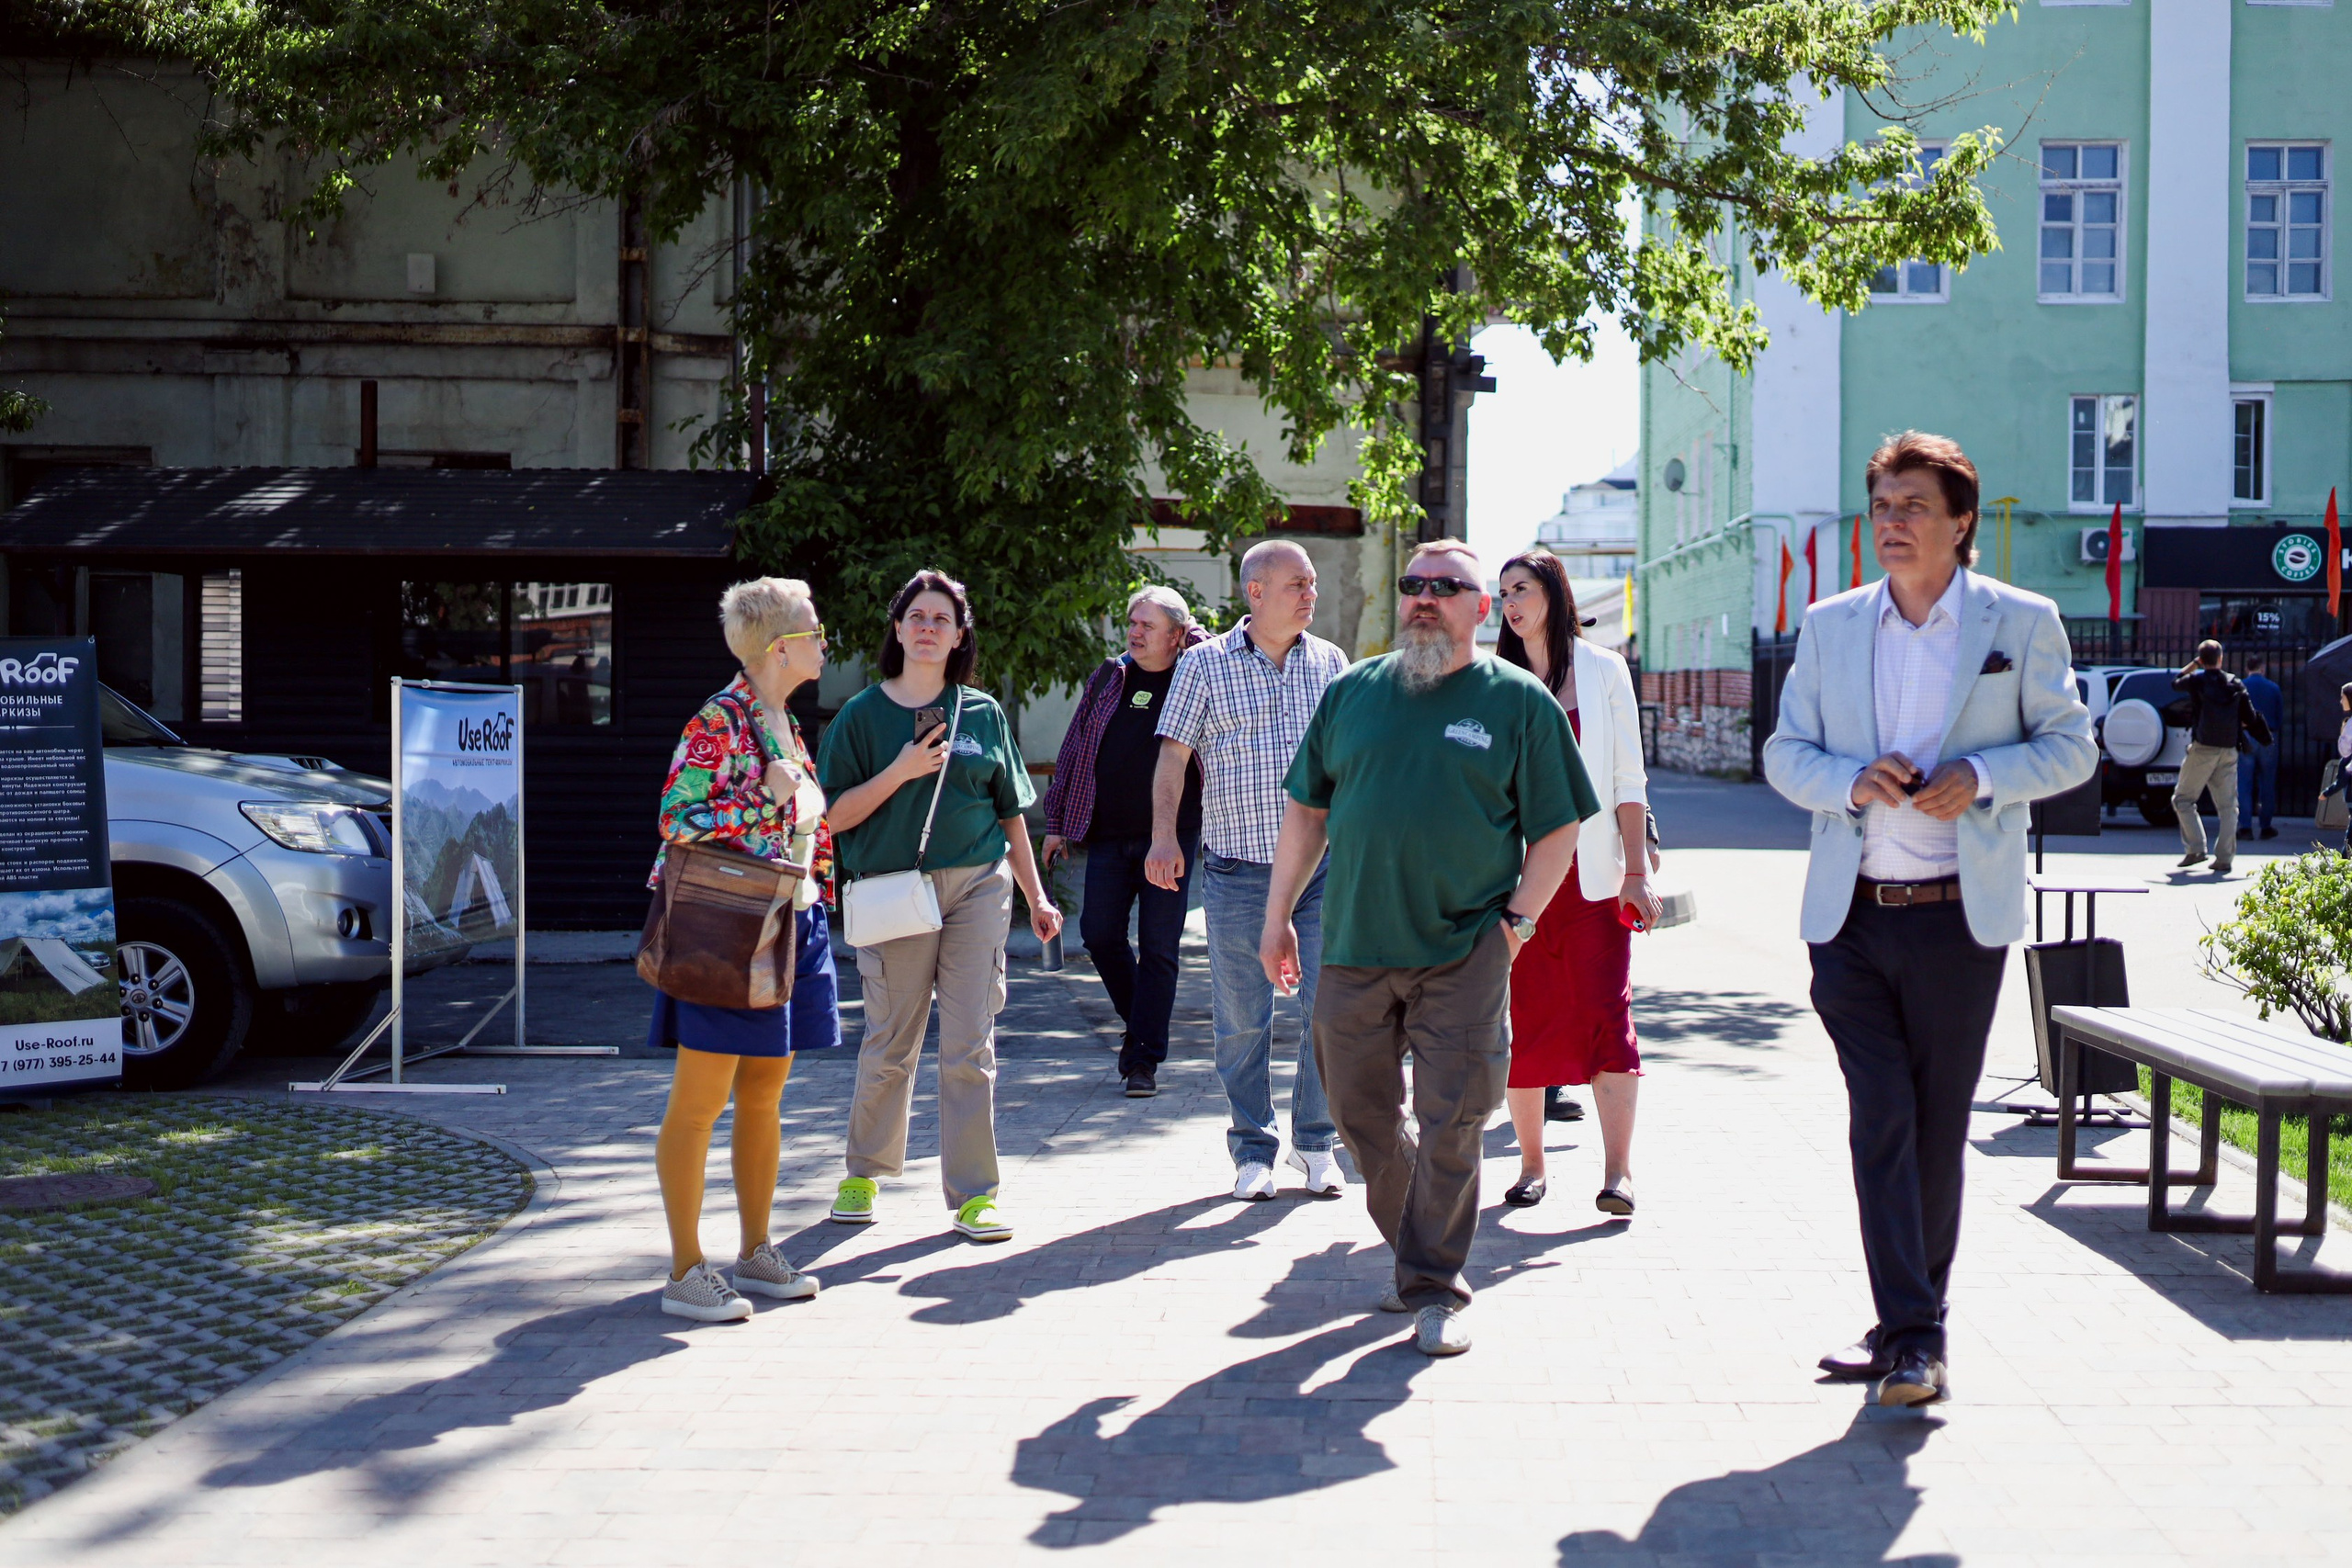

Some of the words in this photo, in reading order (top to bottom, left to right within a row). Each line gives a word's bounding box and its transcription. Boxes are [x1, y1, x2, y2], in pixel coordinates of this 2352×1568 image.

[2278, 537, 2316, 553] STORIES
[2281, 565, 2315, 578] COFFEE
[0, 695, 62, 705] ОБИЛЬНЫЕ
[0, 707, 40, 716] РКИЗЫ
[16, 1036, 94, 1051] Use-Roof.ru
[14, 1057, 44, 1072] (977)
[49, 1053, 116, 1068] 395-25-44
